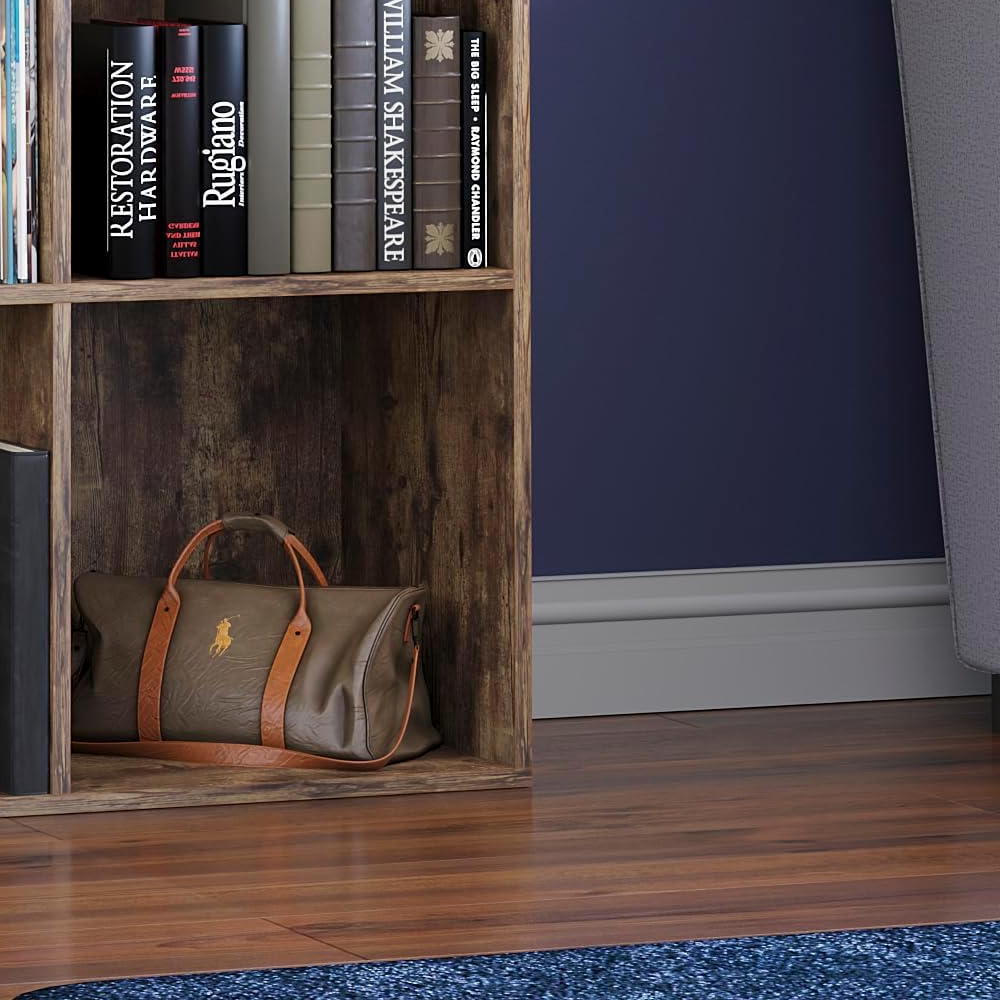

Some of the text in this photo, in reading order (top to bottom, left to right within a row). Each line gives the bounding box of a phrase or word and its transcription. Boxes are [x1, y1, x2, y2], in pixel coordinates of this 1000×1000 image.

[110, 60, 134, 239] RESTORATION
[139, 76, 157, 222] HARDWARE
[202, 101, 247, 208] Rugiano
[383, 102, 405, 262] SHAKESPEARE
[470, 37, 481, 240] THE BIG SLEEP RAYMOND CHANDLER
